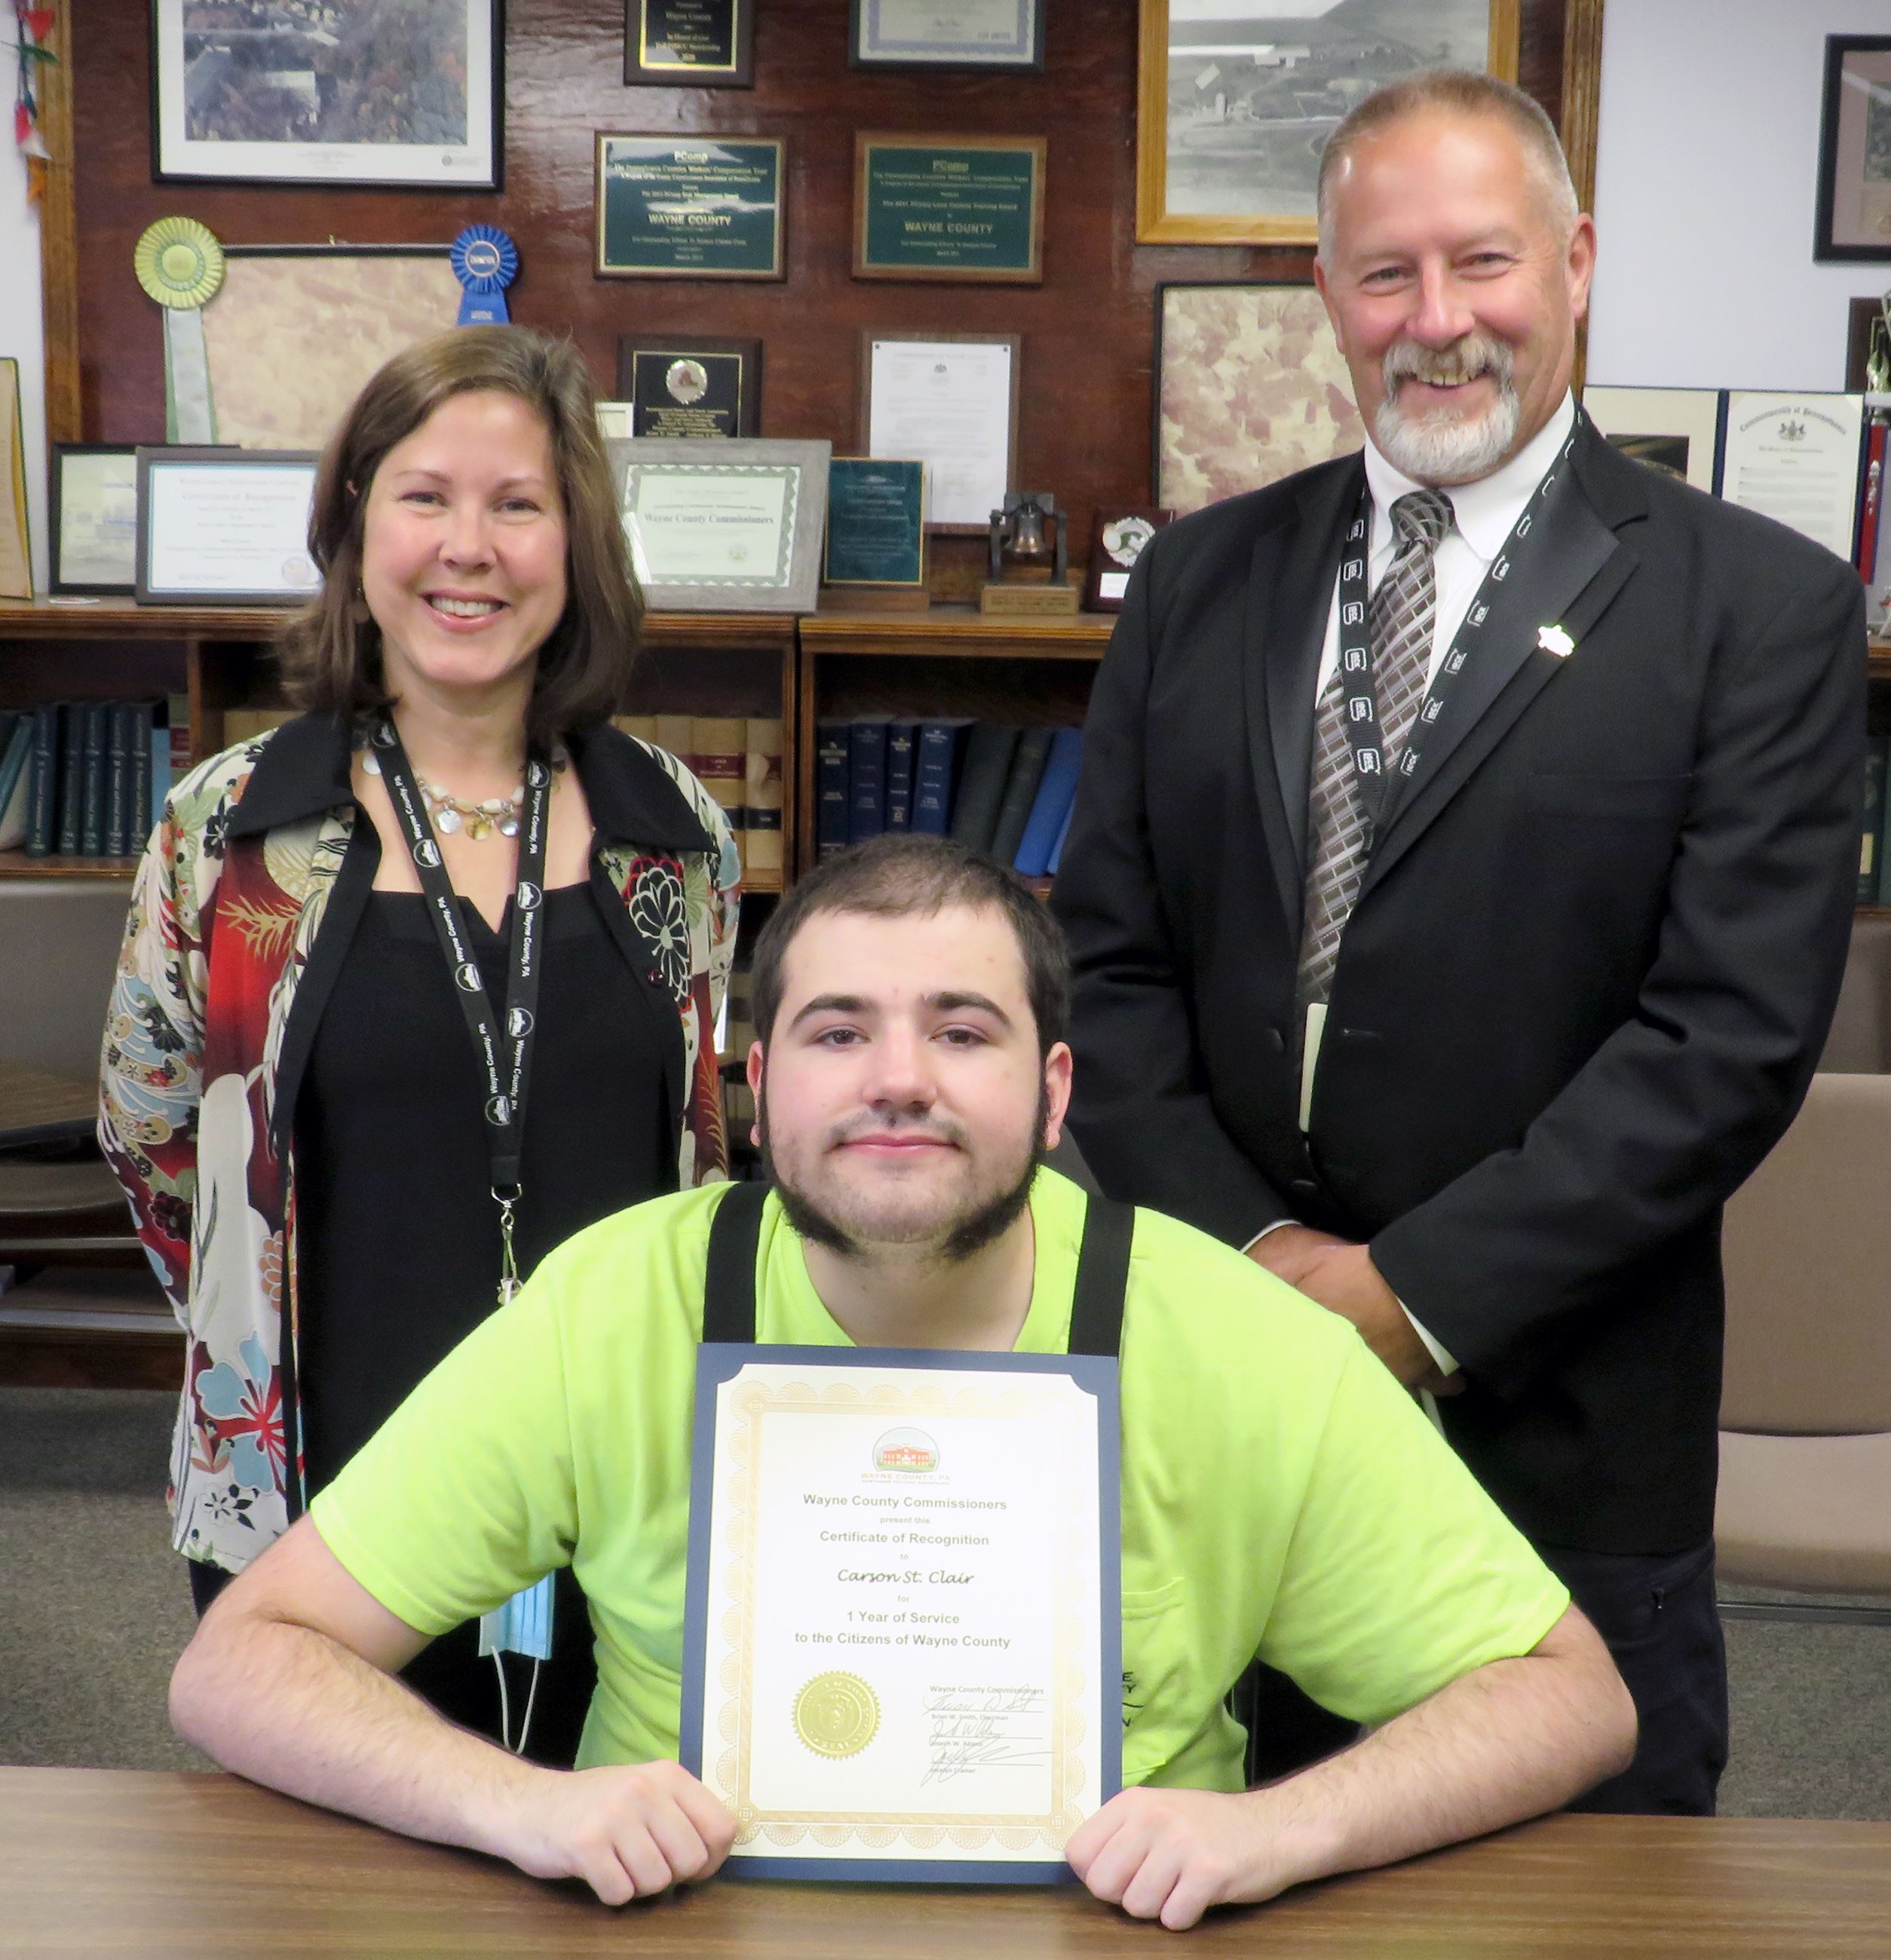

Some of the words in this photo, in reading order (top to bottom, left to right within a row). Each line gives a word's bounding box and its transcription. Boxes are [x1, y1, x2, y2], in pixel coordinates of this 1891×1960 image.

[648, 214, 685, 225] WAYNE
[688, 216, 731, 226] COUNTY
[904, 222, 943, 233] WAYNE
[947, 222, 993, 234] COUNTY
[645, 513, 673, 524] Wayne
[676, 514, 706, 525] County
[709, 514, 774, 525] Commissioners
[394, 774, 403, 786] PA
[532, 790, 543, 815] Wayne
[409, 815, 423, 840] Wayne
[529, 843, 538, 854] PA
[437, 896, 447, 908] PA
[443, 908, 457, 937] County,
[523, 911, 534, 936] Wayne
[452, 937, 465, 963] Wayne
[521, 966, 531, 977] PA
[478, 1023, 487, 1034] PA
[513, 1040, 525, 1067] Wayne
[489, 1066, 499, 1094] Wayne
[511, 1100, 518, 1110] PA
[803, 1493, 848, 1508] Wayne
[851, 1495, 900, 1509] County
[903, 1496, 1007, 1510] Commissioners
[880, 1517, 913, 1525] present
[820, 1530, 888, 1543] Certificate
[892, 1533, 906, 1543] of
[909, 1533, 989, 1547] Recognition
[837, 1569, 901, 1583] Carson
[902, 1570, 923, 1584] St.
[928, 1570, 975, 1585] Clair
[897, 1594, 910, 1603] for
[847, 1610, 853, 1622] 1
[858, 1610, 889, 1623] Year
[893, 1612, 906, 1623] of
[910, 1612, 960, 1624] Service
[795, 1632, 808, 1643] to
[812, 1631, 833, 1643] the
[837, 1632, 891, 1645] Citizens
[895, 1634, 909, 1645] of
[912, 1634, 958, 1648] Wayne
[962, 1635, 1010, 1650] County
[929, 1685, 956, 1693] Wayne
[958, 1686, 985, 1694] County
[986, 1686, 1044, 1695] Commissioners
